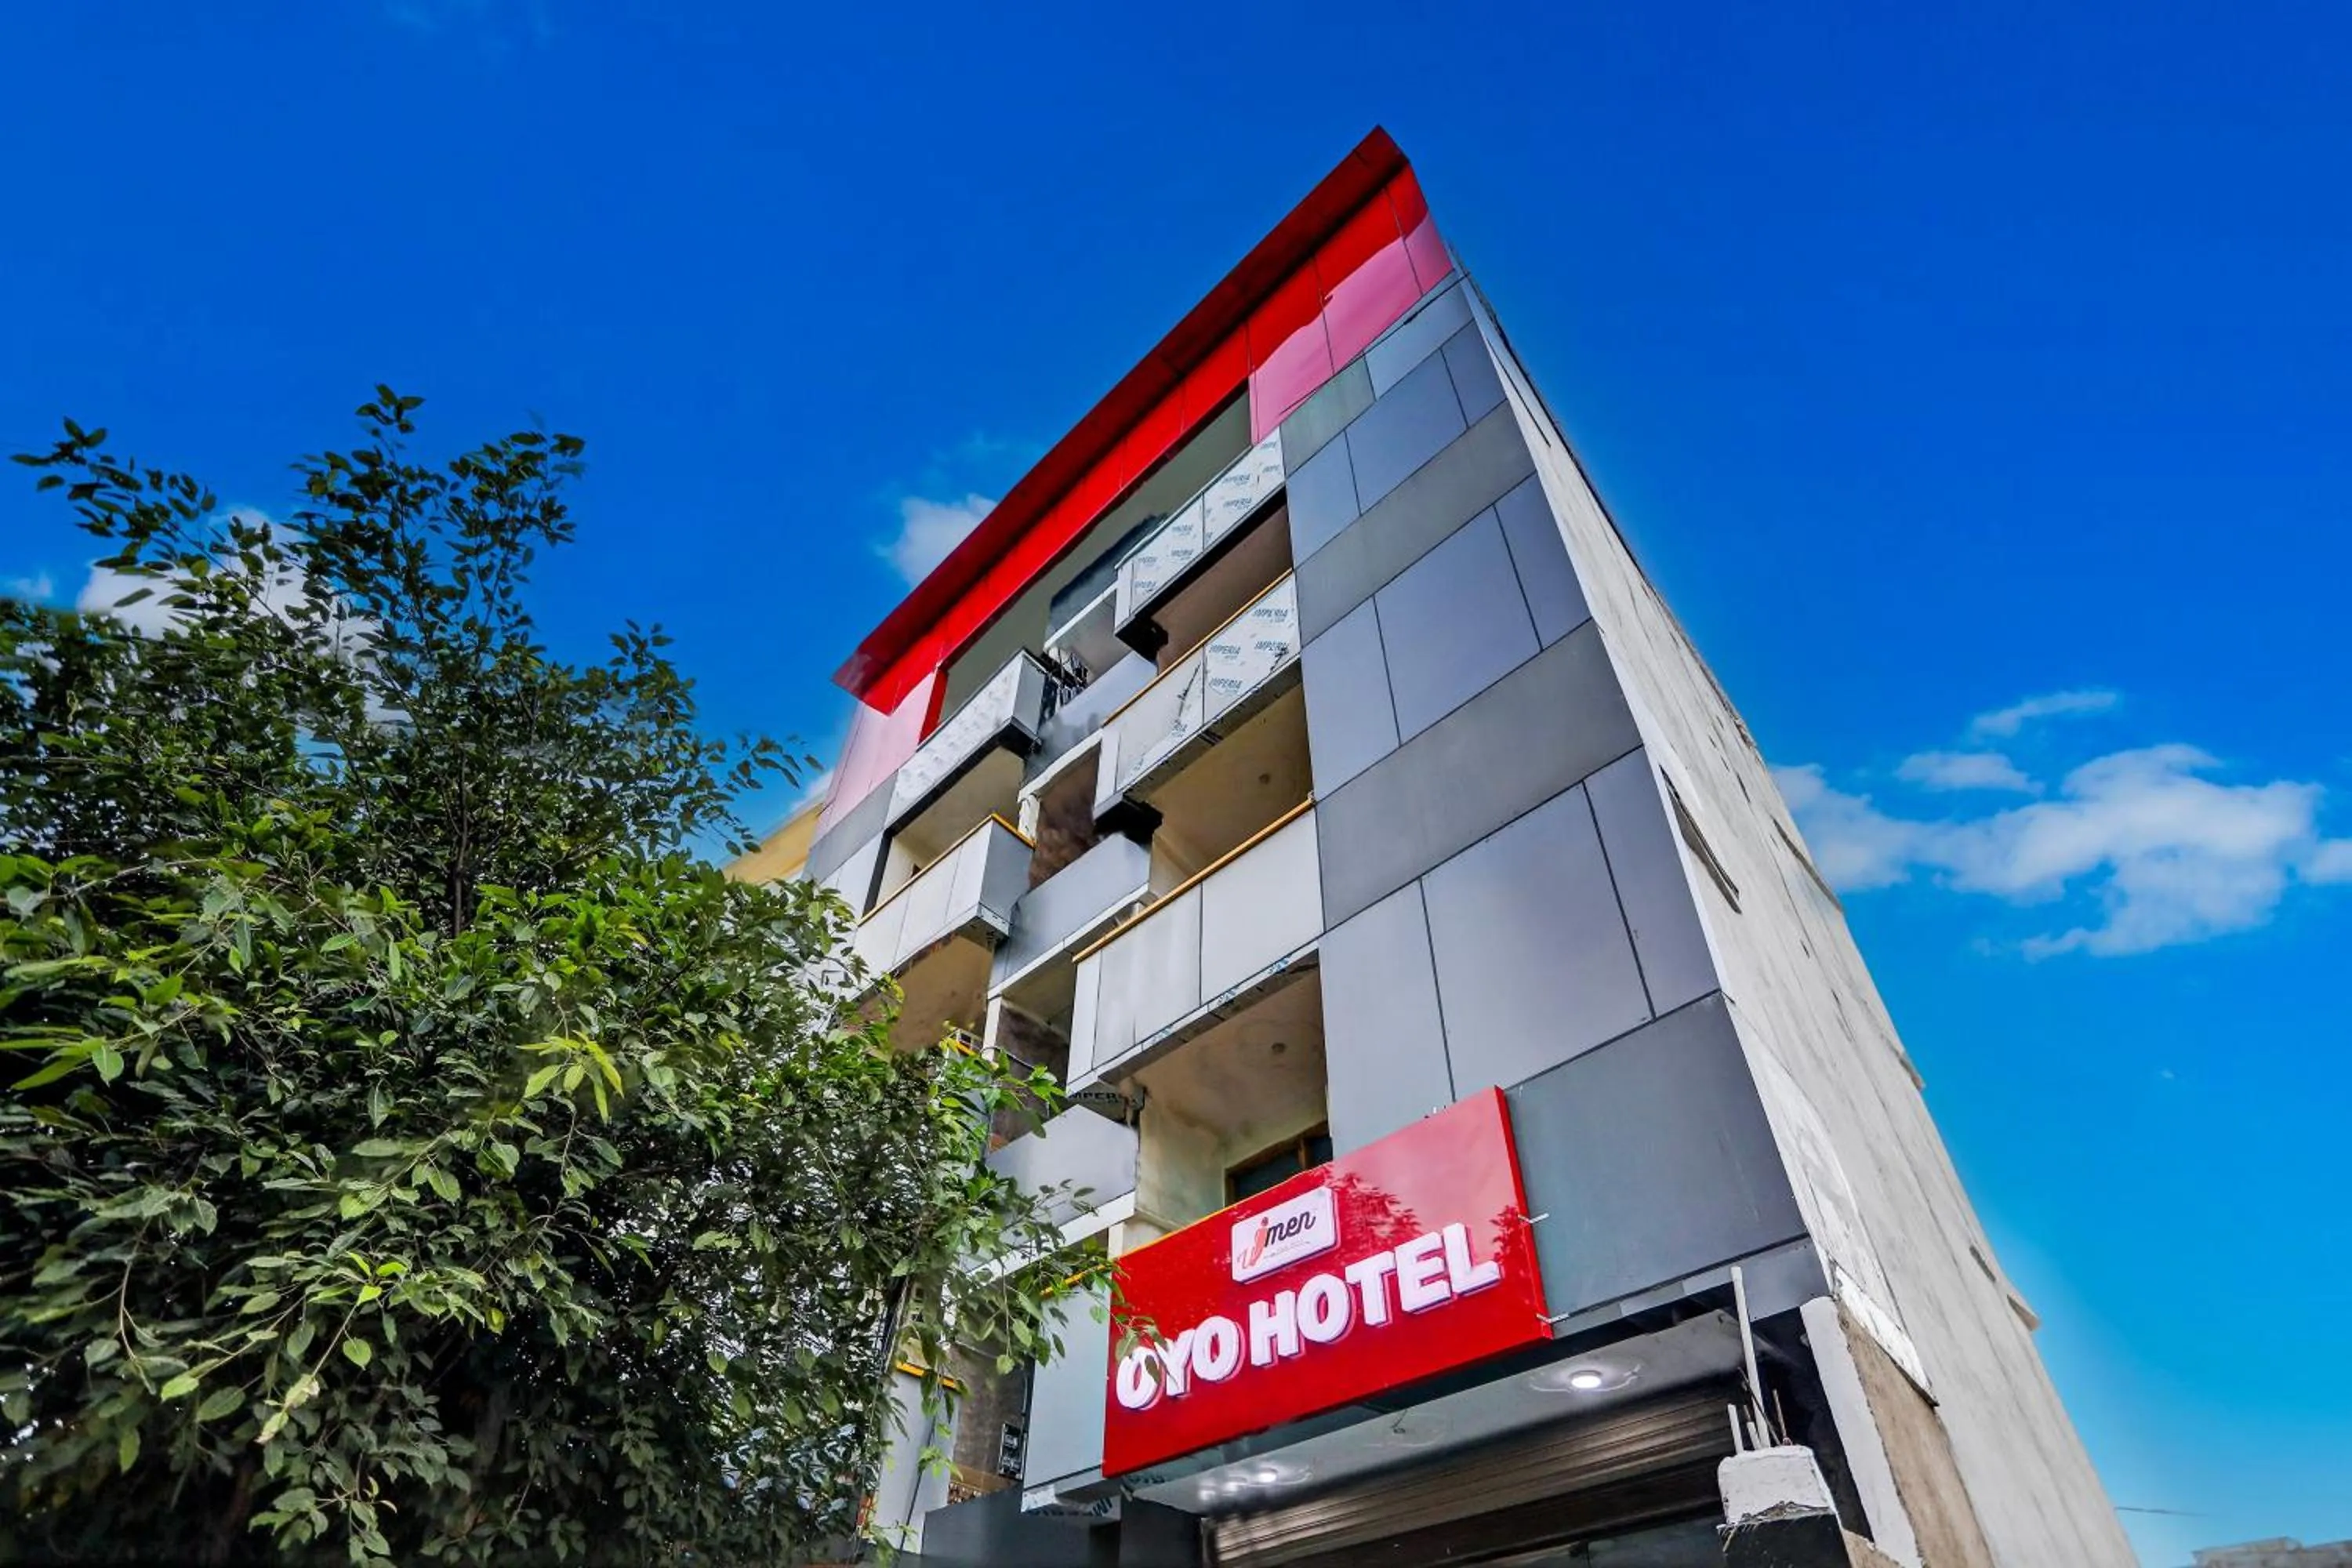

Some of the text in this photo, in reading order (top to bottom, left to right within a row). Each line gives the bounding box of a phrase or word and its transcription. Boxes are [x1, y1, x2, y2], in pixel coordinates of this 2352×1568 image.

[1253, 608, 1288, 618] IMPERIA
[1208, 644, 1241, 655] IMPERIA
[1208, 677, 1243, 689] IMPERIA
[1116, 1221, 1501, 1410] OYO HOTEL
